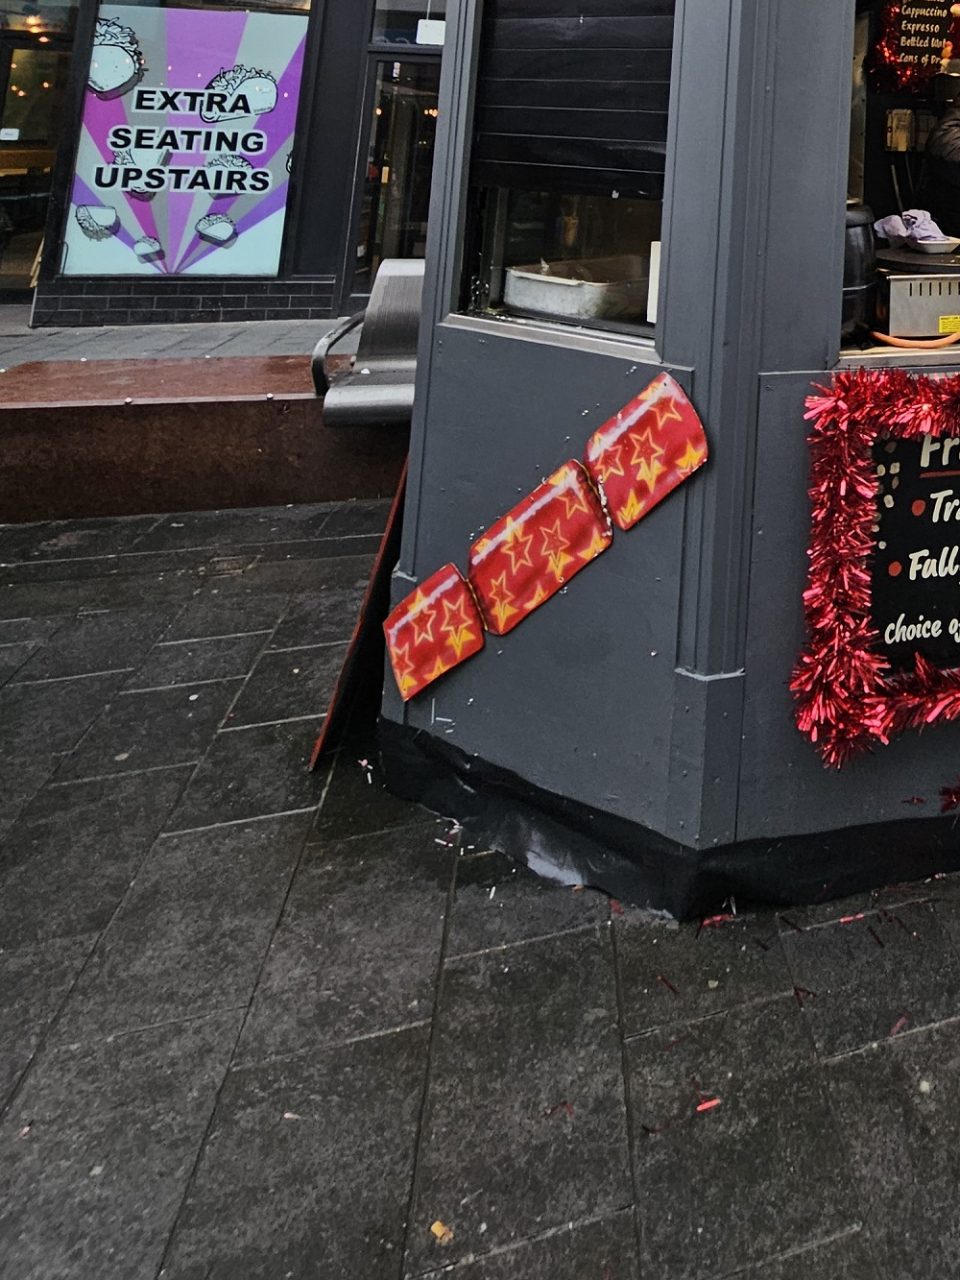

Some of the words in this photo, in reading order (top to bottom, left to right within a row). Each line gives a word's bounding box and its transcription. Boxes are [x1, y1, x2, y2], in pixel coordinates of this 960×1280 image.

[901, 4, 948, 18] Cappuccino
[901, 21, 940, 34] Expresso
[900, 36, 930, 48] Bottled
[930, 37, 946, 48] Wat
[135, 90, 251, 114] EXTRA
[110, 127, 264, 152] SEATING
[94, 167, 270, 191] UPSTAIRS
